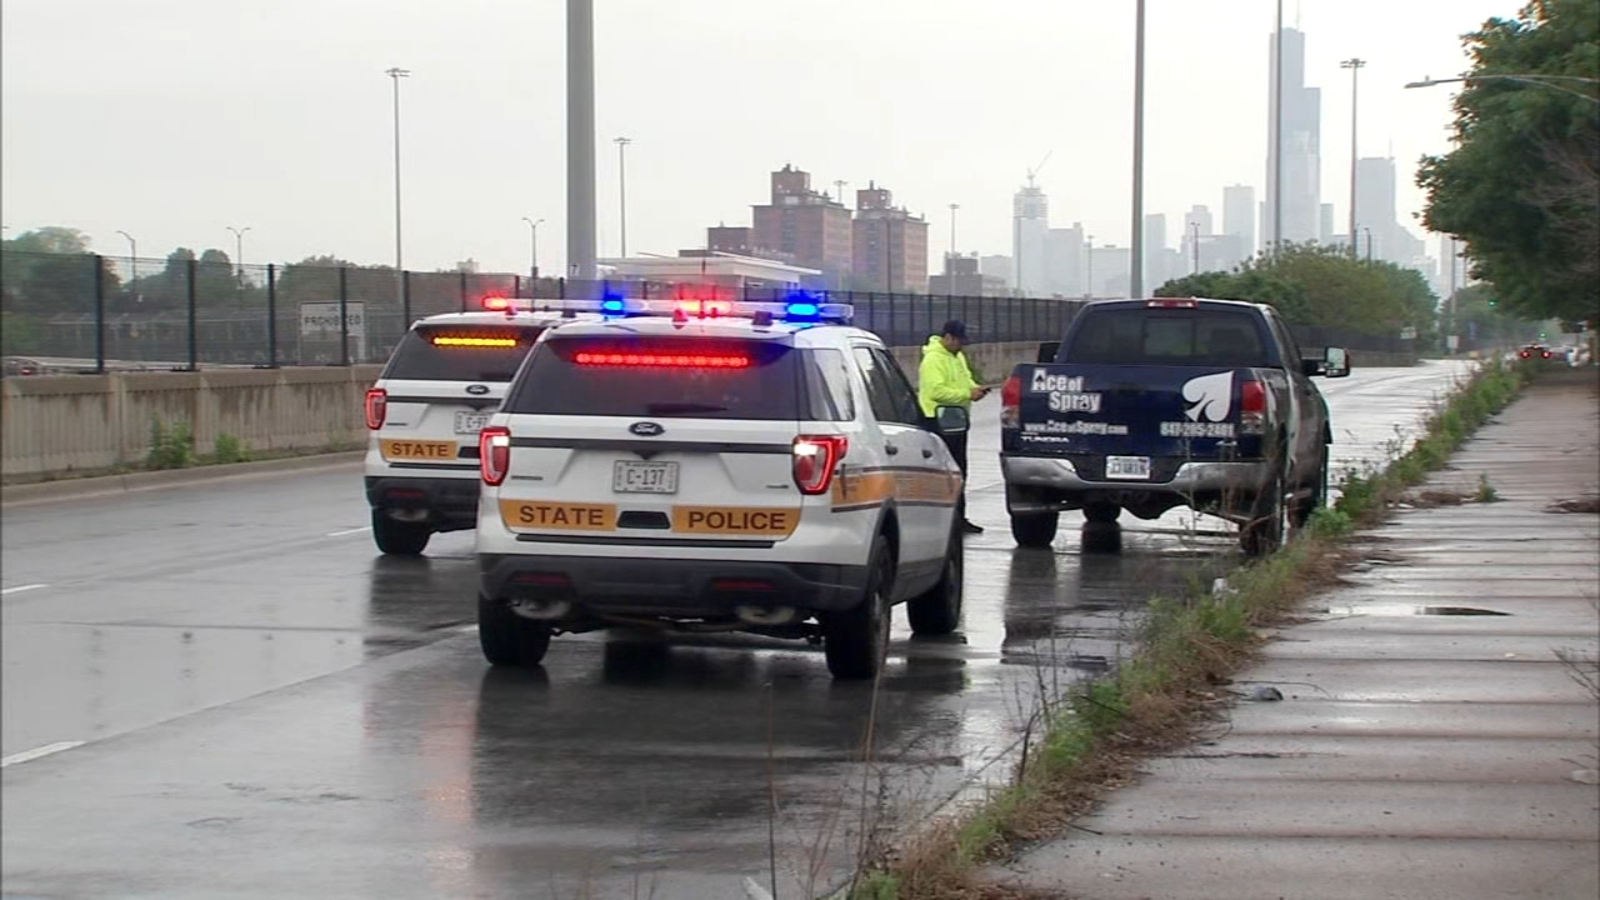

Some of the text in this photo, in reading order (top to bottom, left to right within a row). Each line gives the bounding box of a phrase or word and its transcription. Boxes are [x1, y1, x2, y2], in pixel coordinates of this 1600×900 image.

[304, 314, 361, 326] PROHIBED
[1031, 368, 1083, 392] Ace of
[1049, 391, 1102, 413] Spray
[391, 443, 448, 457] STATE
[626, 469, 666, 485] C-137
[519, 505, 787, 530] STATE POLICE
